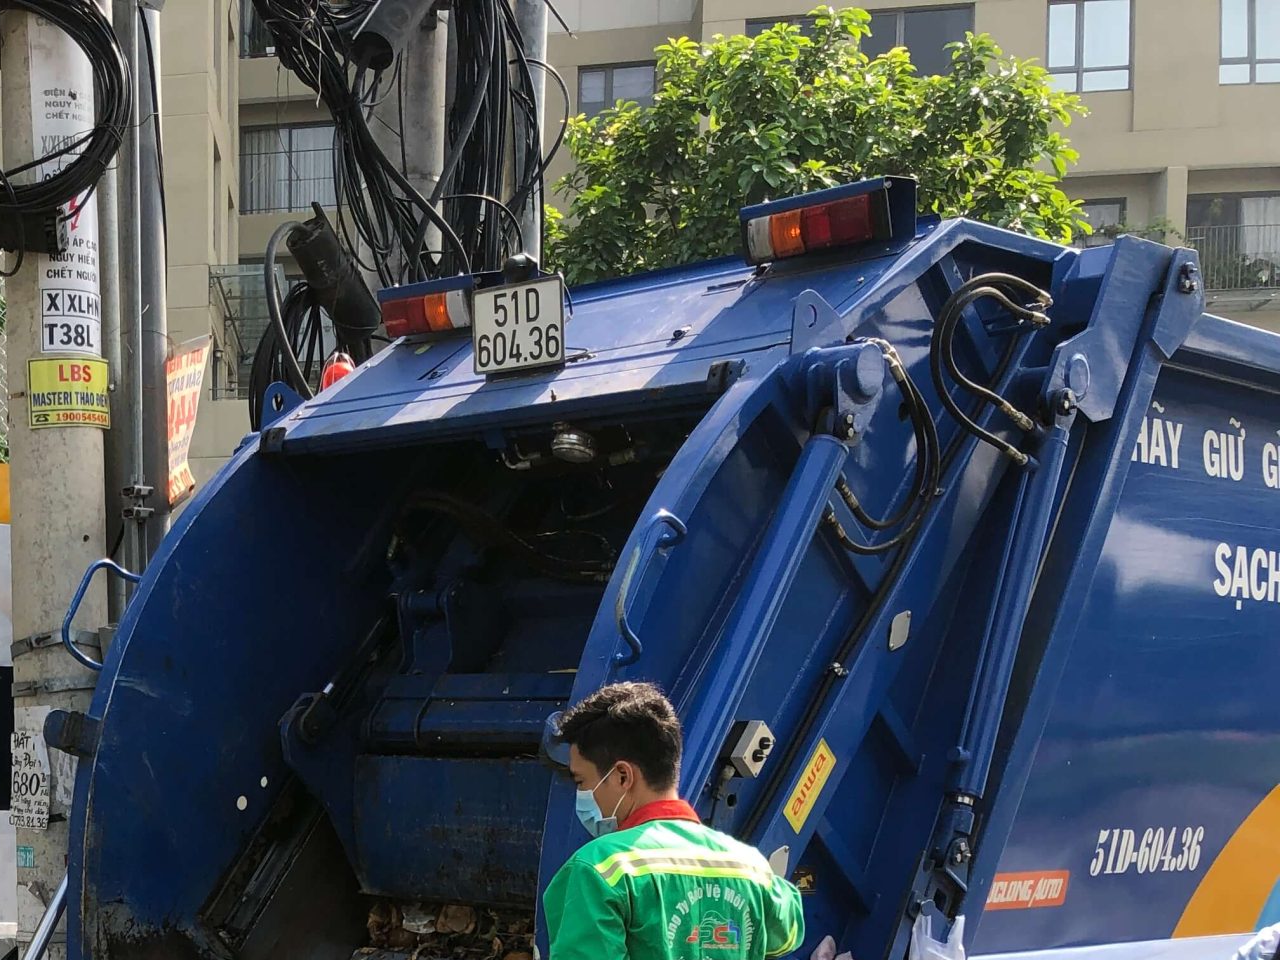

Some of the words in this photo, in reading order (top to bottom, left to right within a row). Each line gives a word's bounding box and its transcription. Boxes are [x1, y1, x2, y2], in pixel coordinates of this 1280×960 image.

[72, 235, 85, 248] ÁP
[46, 265, 73, 279] CHẾT
[47, 293, 60, 312] X
[493, 287, 540, 328] 51D
[44, 323, 94, 348] T38L
[478, 324, 560, 368] 604.36
[58, 364, 92, 382] LBS
[32, 391, 72, 408] MASTERI
[1131, 400, 1183, 469] HÃY
[1202, 417, 1246, 481] GIỮ
[13, 771, 40, 796] 680
[791, 752, 827, 816] aiwa
[1090, 826, 1205, 877] 51D-604.36
[705, 883, 721, 902] Vệ
